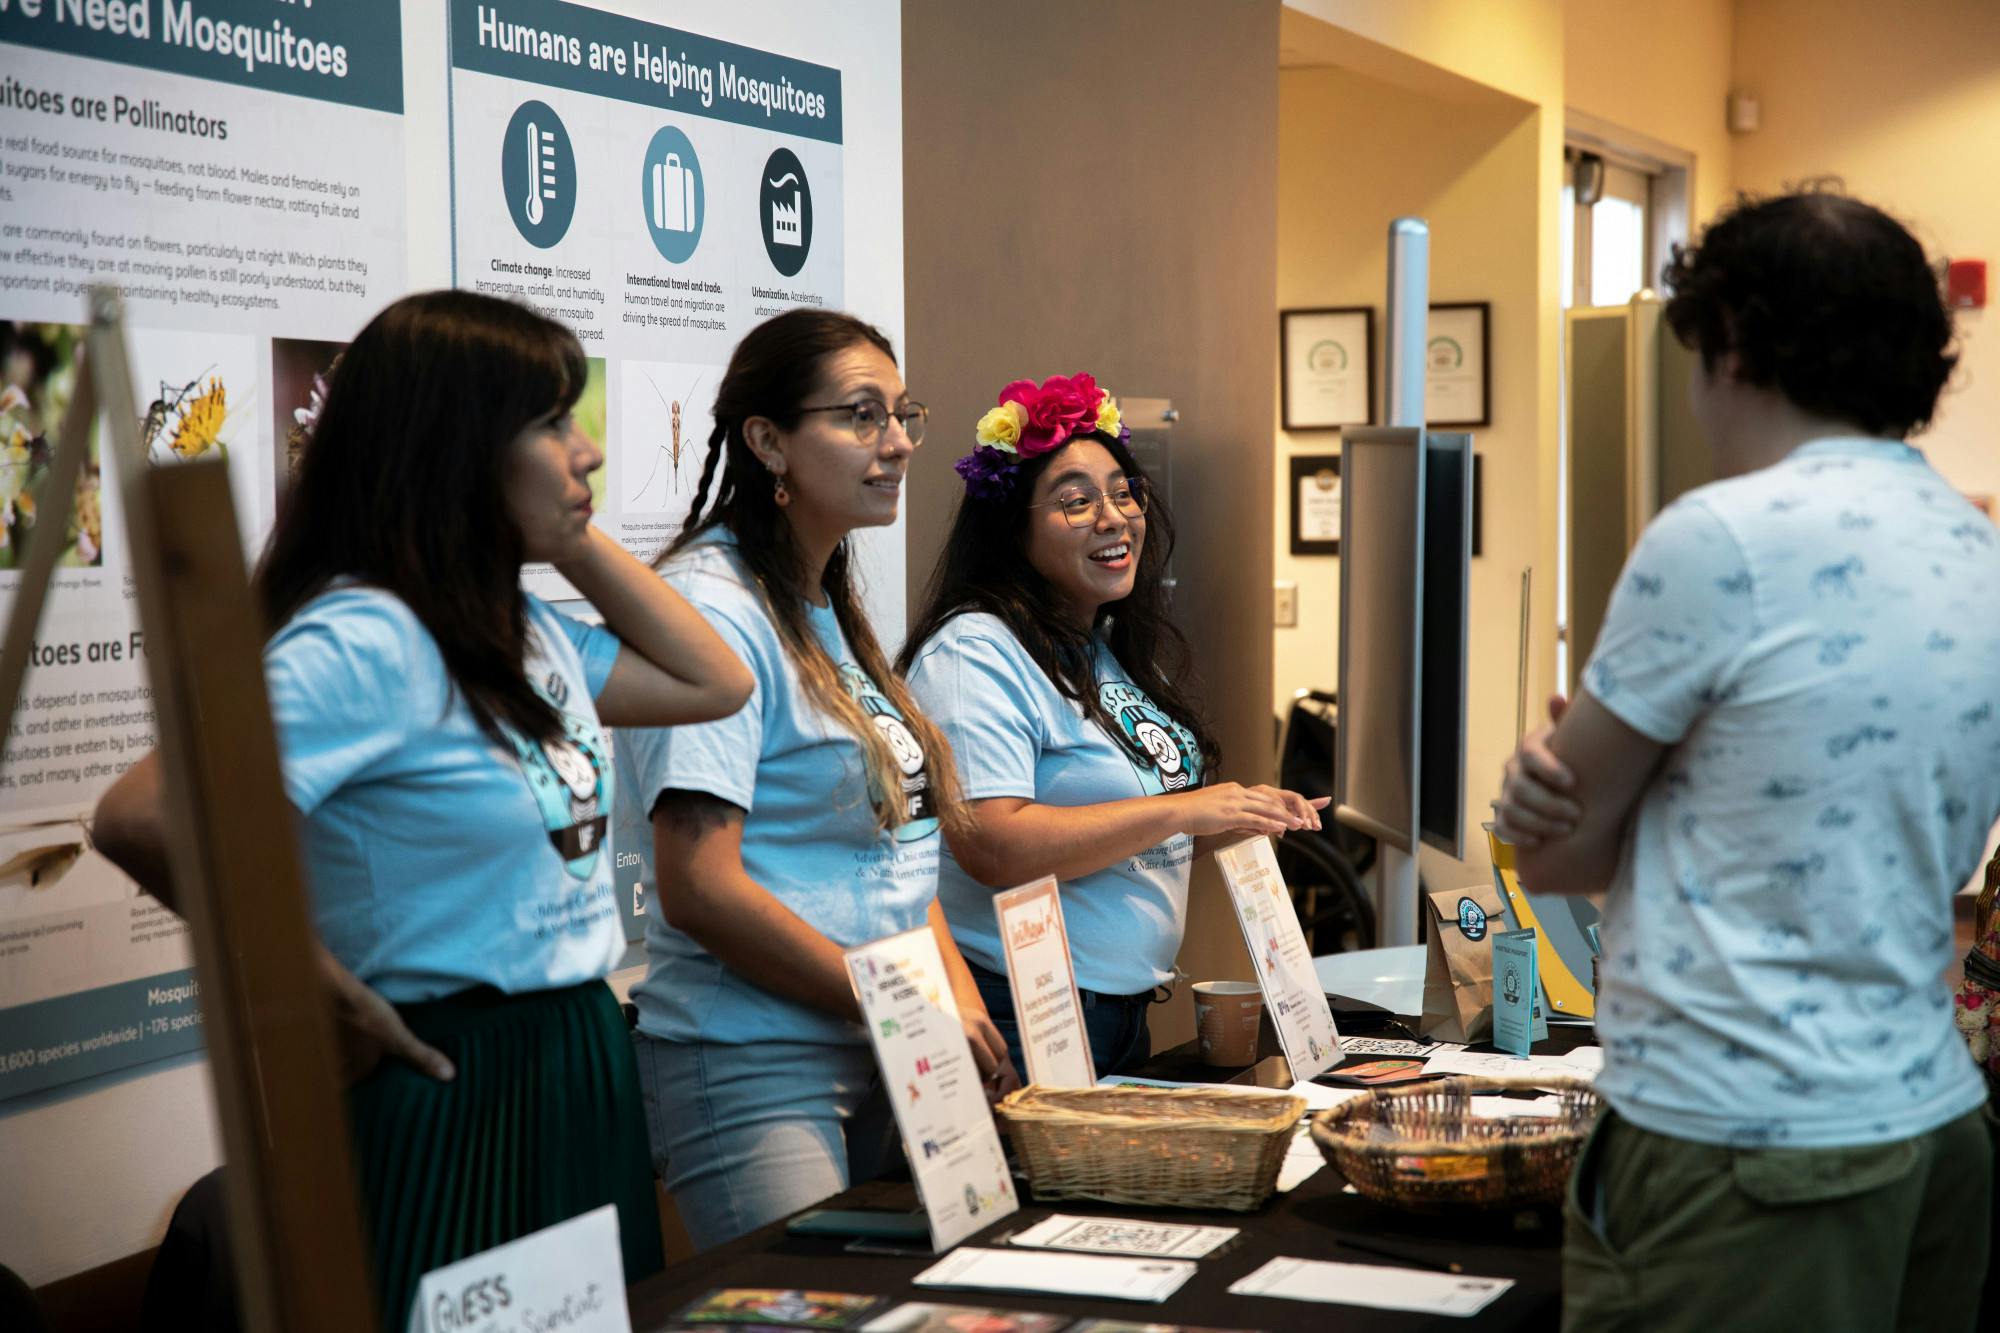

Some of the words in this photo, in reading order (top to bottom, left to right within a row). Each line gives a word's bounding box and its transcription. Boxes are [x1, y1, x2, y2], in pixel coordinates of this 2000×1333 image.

[56, 0, 150, 39] Need
[163, 1, 348, 78] Mosquitoes
[477, 5, 582, 66] Humans
[589, 40, 627, 77] are
[633, 39, 713, 109] Helping
[719, 60, 826, 119] Mosquitoes
[71, 96, 107, 121] are
[114, 96, 228, 140] Pollinators
[5, 136, 29, 152] real
[31, 138, 60, 156] food
[62, 146, 99, 161] source
[101, 148, 118, 164] for
[119, 155, 186, 176] mosquitoes,
[187, 162, 206, 176] not
[207, 163, 238, 180] blood.
[241, 168, 270, 186] Males
[271, 173, 290, 188] and
[292, 175, 329, 194] females
[330, 181, 346, 199] rely
[348, 185, 360, 198] on
[6, 164, 47, 182] sugars
[49, 164, 66, 182] for
[68, 173, 109, 192] energy
[110, 175, 122, 190] to
[125, 176, 140, 195] fly
[154, 180, 194, 201] feeding
[196, 185, 221, 201] from
[222, 188, 253, 206] flower
[254, 194, 287, 212] nectar,
[288, 200, 319, 218] rotting
[321, 201, 341, 217] fruit
[341, 206, 359, 219] and
[25, 226, 89, 248] commonly
[91, 231, 125, 248] found
[127, 238, 141, 249] on
[144, 236, 185, 255] flowers,
[187, 243, 243, 264] particularly
[246, 249, 256, 262] at
[259, 250, 286, 267] night.
[288, 252, 316, 268] Which
[318, 255, 346, 271] plants
[348, 260, 367, 276] they
[15, 249, 66, 268] effective
[68, 254, 95, 273] they
[97, 259, 116, 271] are
[118, 260, 130, 273] at
[132, 262, 173, 280] moving
[175, 264, 207, 280] pollen
[209, 267, 218, 281] is
[219, 268, 237, 282] still
[239, 272, 270, 289] poorly
[272, 275, 327, 293] understood,
[328, 278, 344, 293] but
[345, 280, 366, 298] they
[491, 259, 522, 273] Climate
[524, 262, 553, 279] change.
[556, 265, 591, 280] Increased
[475, 279, 526, 297] temperature,
[527, 283, 556, 299] rainfall,
[557, 287, 572, 299] and
[573, 289, 605, 304] humidity
[626, 273, 671, 289] International
[671, 279, 690, 292] travel
[691, 281, 703, 292] and
[704, 281, 723, 294] trade.
[752, 286, 790, 301] Urbanization.
[790, 290, 822, 305] Accelerating
[180, 287, 219, 308] healthy
[221, 293, 280, 310] ecosystems.
[624, 292, 650, 305] Human
[651, 295, 669, 307] travel
[670, 296, 683, 308] and
[684, 297, 715, 313] migration
[716, 303, 725, 313] are
[559, 308, 594, 321] mosquito
[622, 312, 646, 327] driving
[647, 313, 658, 325] the
[659, 315, 681, 328] spread
[682, 314, 689, 327] of
[690, 317, 726, 331] mosquitoes.
[578, 328, 605, 341] spread.
[88, 639, 122, 663] are
[32, 690, 77, 709] depend
[80, 692, 94, 704] on
[26, 718, 49, 735] and
[52, 715, 81, 732] other
[84, 711, 156, 729] invertebrates
[54, 744, 73, 757] are
[74, 738, 108, 754] eaten
[109, 736, 124, 753] by
[19, 769, 44, 786] and
[46, 767, 81, 782] many
[83, 761, 113, 778] other
[1128, 863, 1137, 872] &
[37, 1041, 80, 1064] species
[82, 1026, 138, 1053] worldwide
[432, 1274, 512, 1333] GUESS
